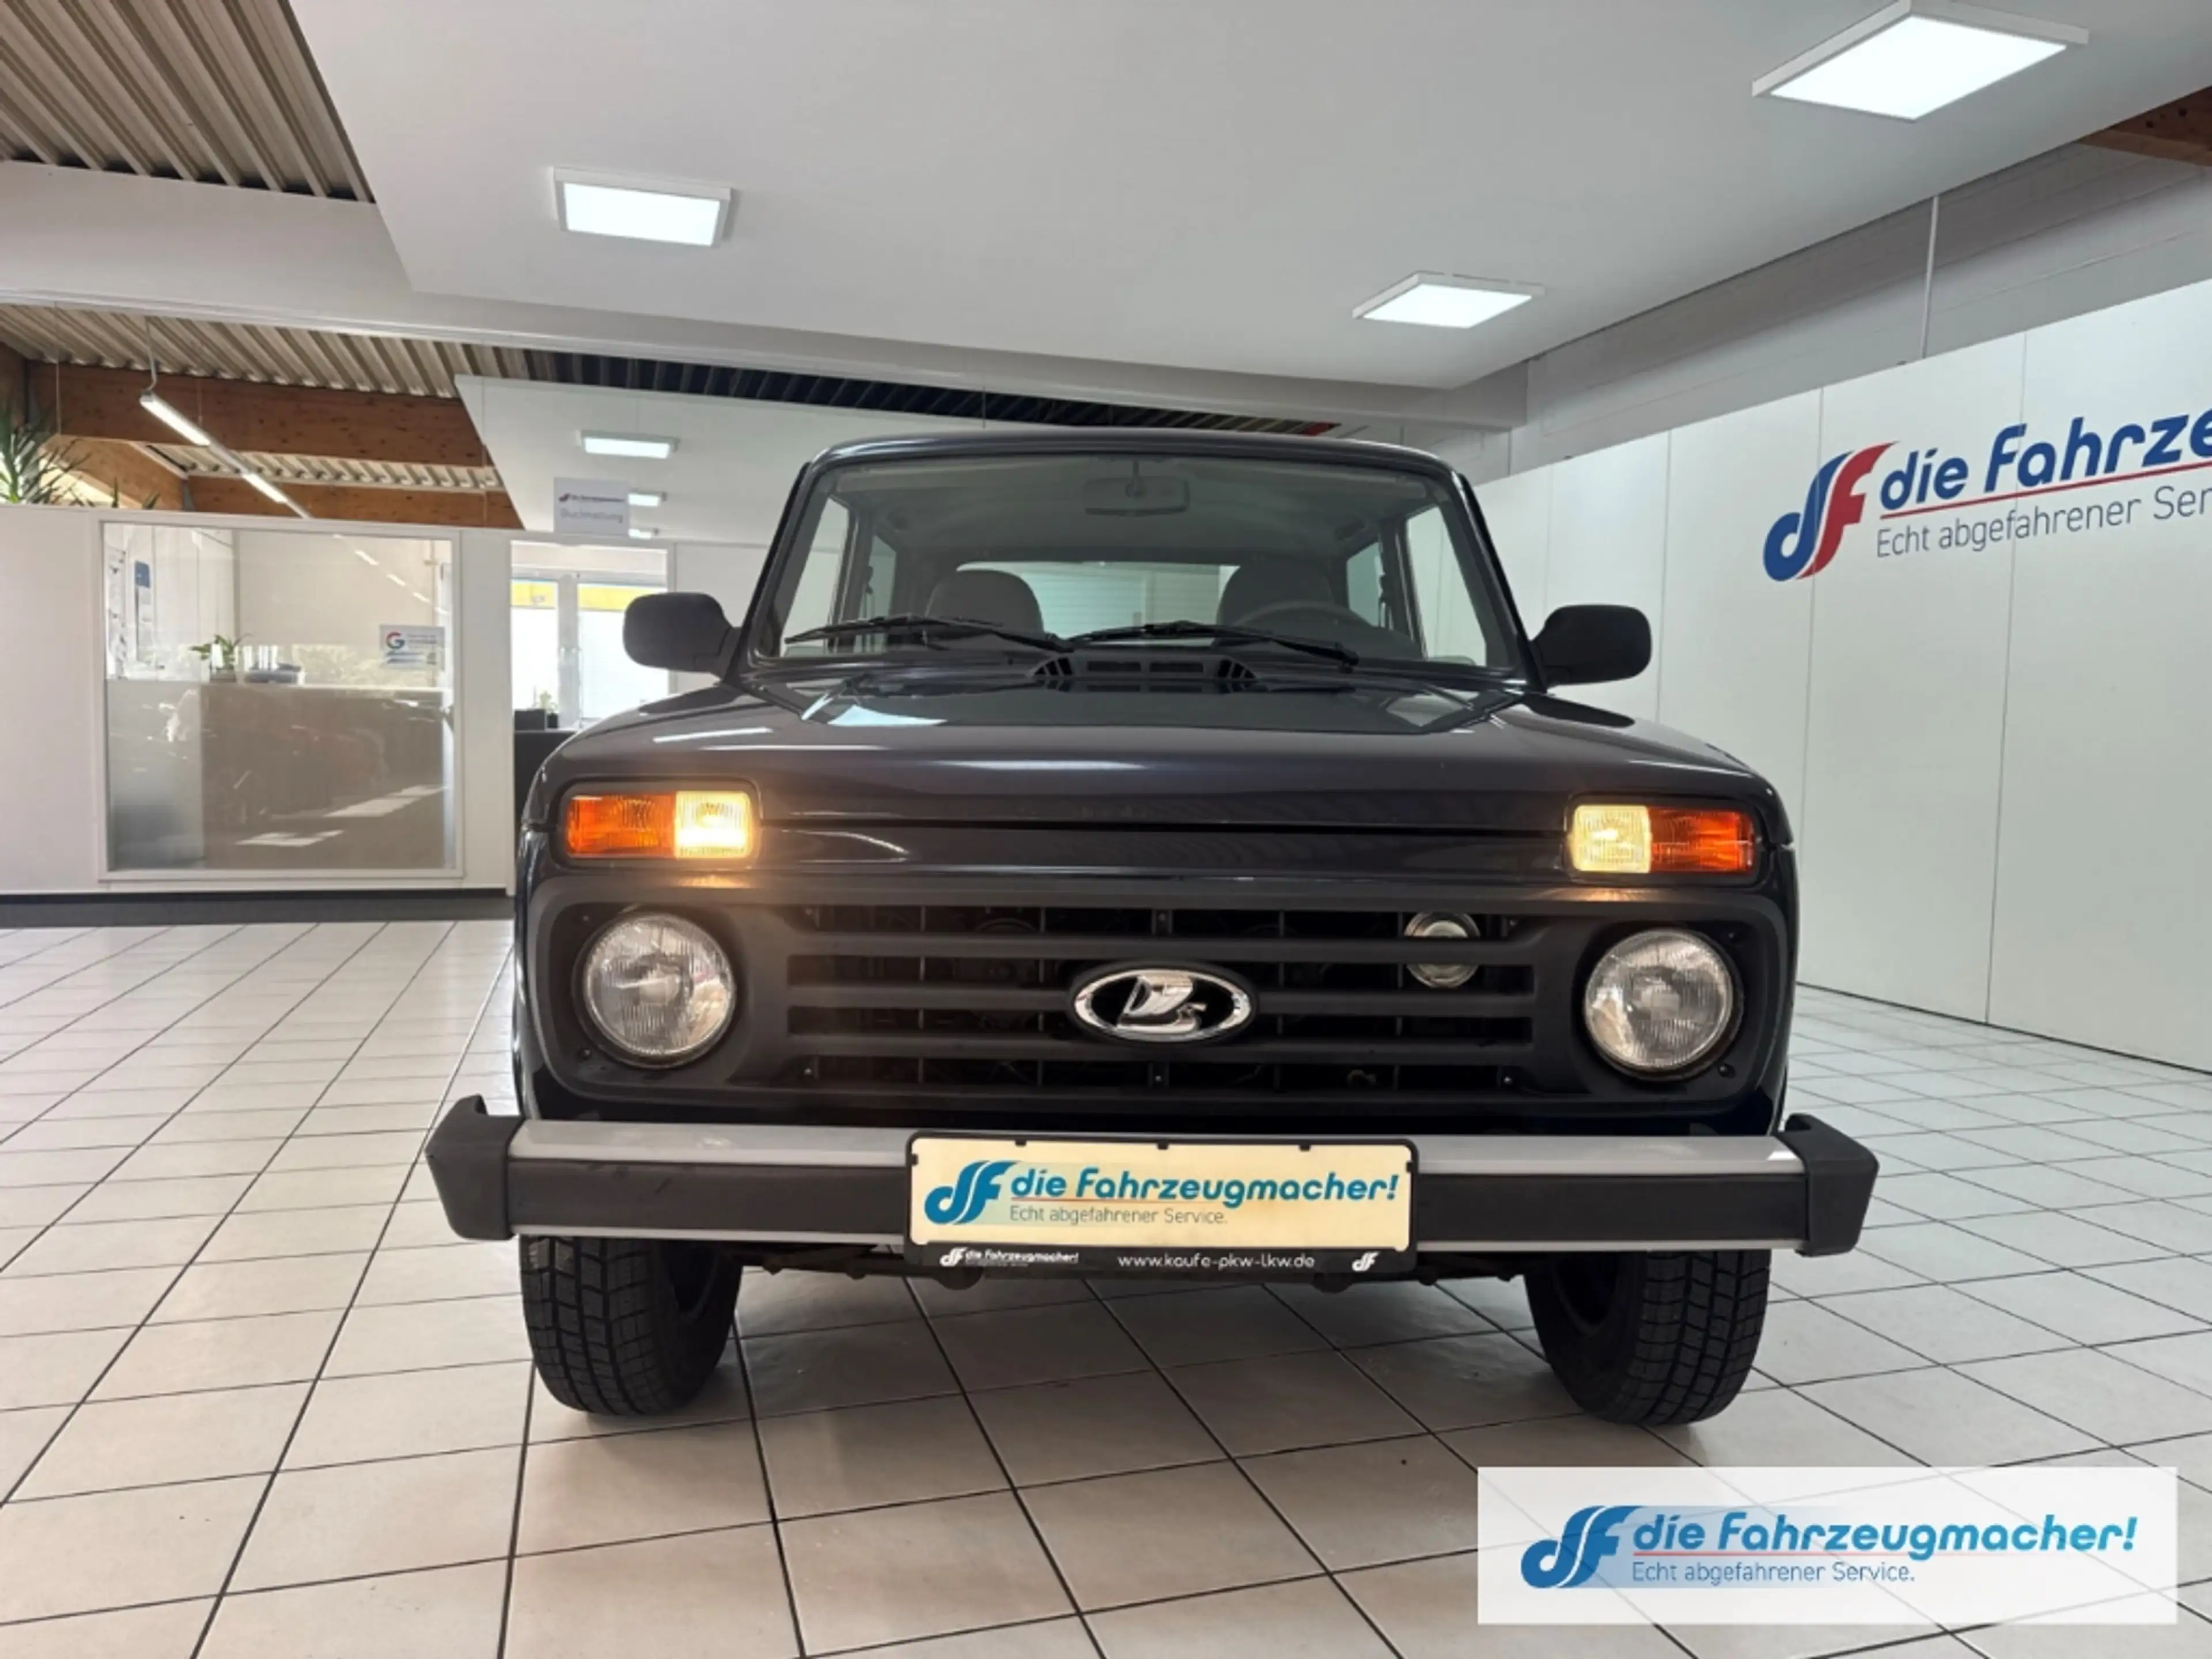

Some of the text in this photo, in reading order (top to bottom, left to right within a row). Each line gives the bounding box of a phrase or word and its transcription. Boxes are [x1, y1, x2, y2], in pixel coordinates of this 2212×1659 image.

[1880, 448, 1968, 510] die
[1877, 518, 1930, 558] Echt
[1939, 497, 2142, 552] abgefahrener
[1011, 1169, 1067, 1197] die
[1076, 1167, 1399, 1209] Fahrzeugmacher!
[1010, 1205, 1228, 1224] Echt abgefahrener Service.
[1118, 1253, 1316, 1270] www.kaufe-pkw-lkw.de
